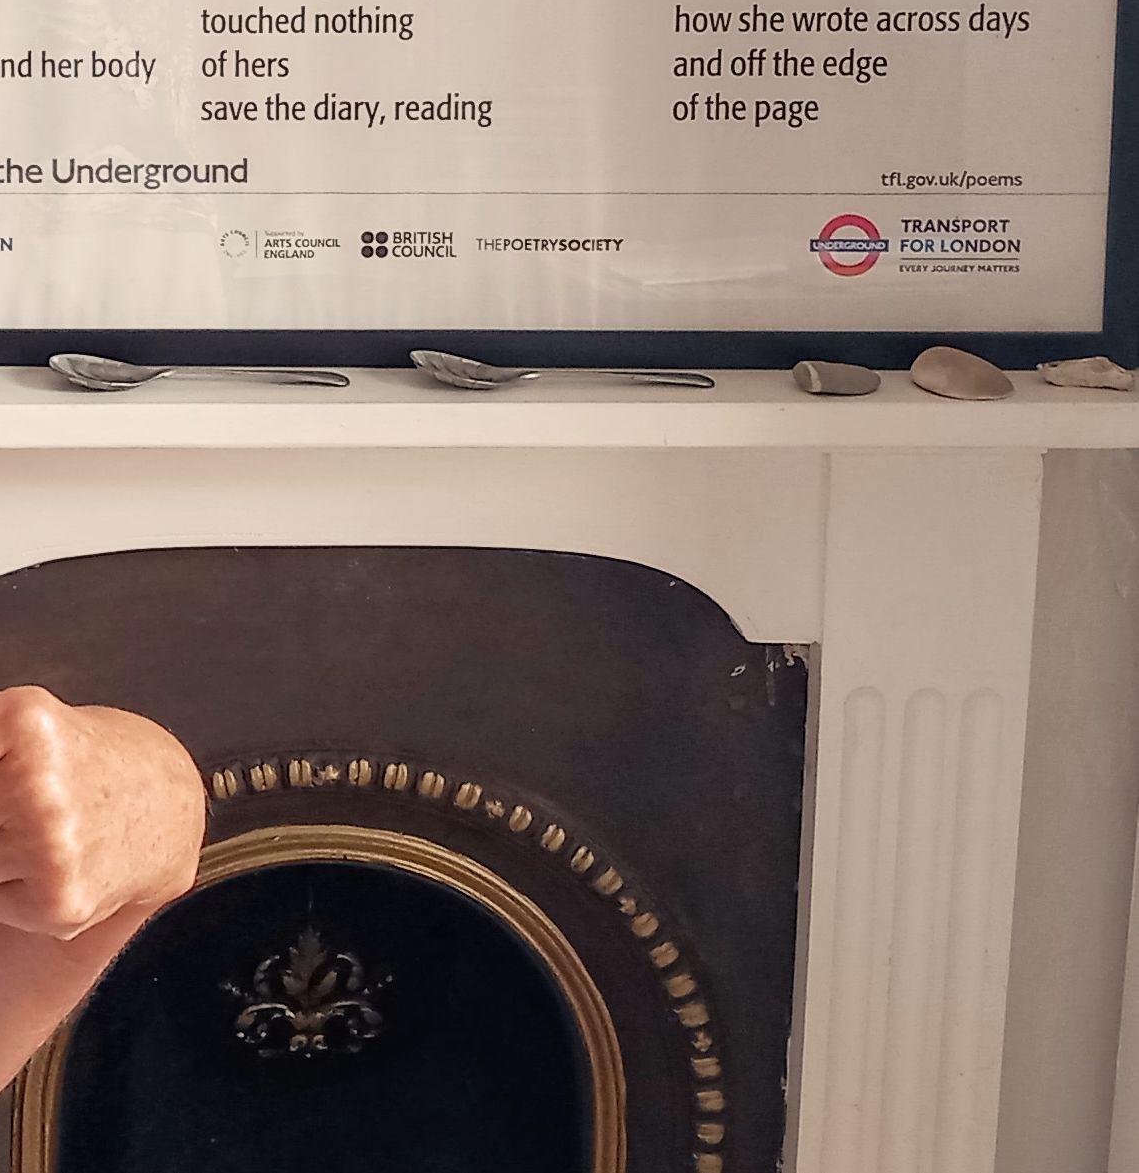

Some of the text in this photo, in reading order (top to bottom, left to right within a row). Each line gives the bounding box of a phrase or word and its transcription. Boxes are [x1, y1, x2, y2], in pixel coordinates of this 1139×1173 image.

[201, 6, 413, 40] touched nothing
[676, 4, 1029, 38] how she wrote across days
[42, 51, 83, 78] her
[92, 51, 156, 84] body
[202, 50, 289, 77] of hers
[674, 48, 887, 83] and off the edge
[201, 93, 492, 128] save the diary, reading
[673, 93, 818, 128] of the page
[53, 158, 247, 189] Underground
[881, 171, 1022, 189] tfl.gov.uk/poems
[901, 219, 1010, 233] TRANSPORT
[264, 239, 340, 248] ARTS COUNCIL
[393, 232, 453, 244] BRITISH
[813, 241, 886, 250] UNDERGROUND
[901, 239, 1020, 253] FOR LONDON
[264, 250, 314, 258] ENGLAND
[392, 245, 456, 257] COUNCIL
